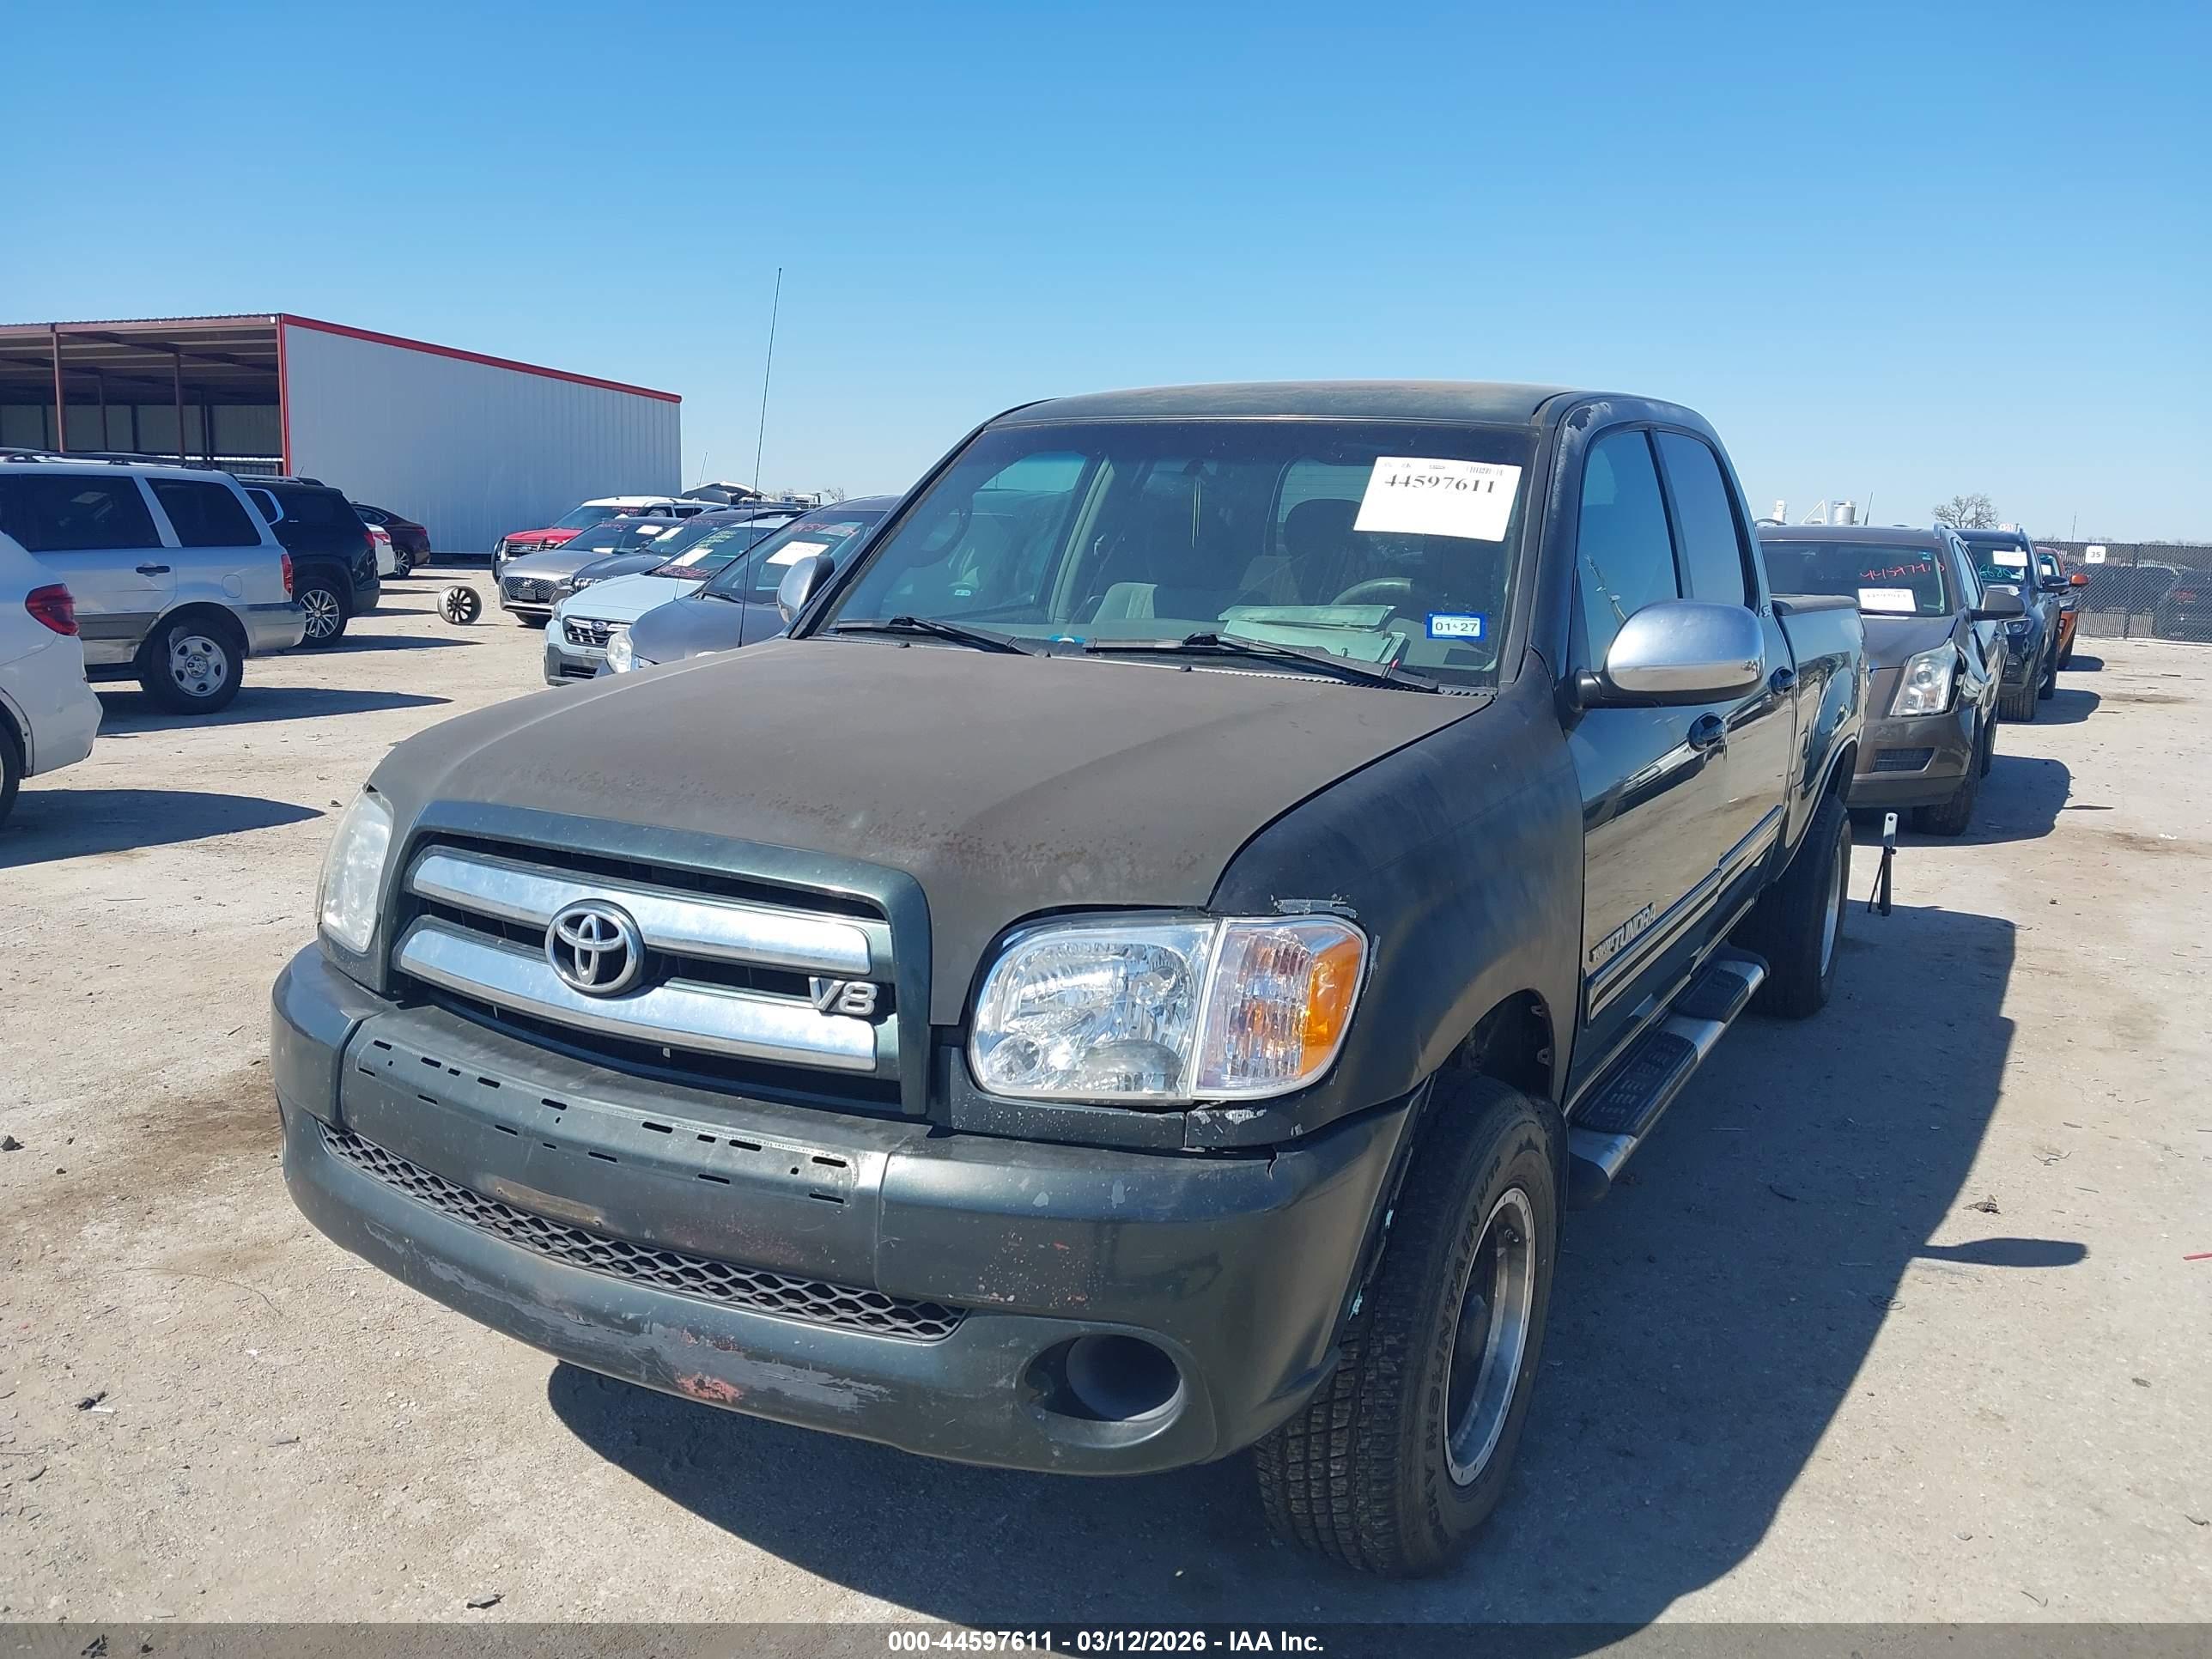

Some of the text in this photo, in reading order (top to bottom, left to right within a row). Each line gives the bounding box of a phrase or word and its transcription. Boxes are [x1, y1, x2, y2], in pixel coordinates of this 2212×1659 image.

[1384, 474, 1496, 494] 44597611
[1614, 902, 1656, 951] TUNDRA
[808, 976, 878, 1016] V8
[1425, 1204, 1480, 1451] MOUNTAIN
